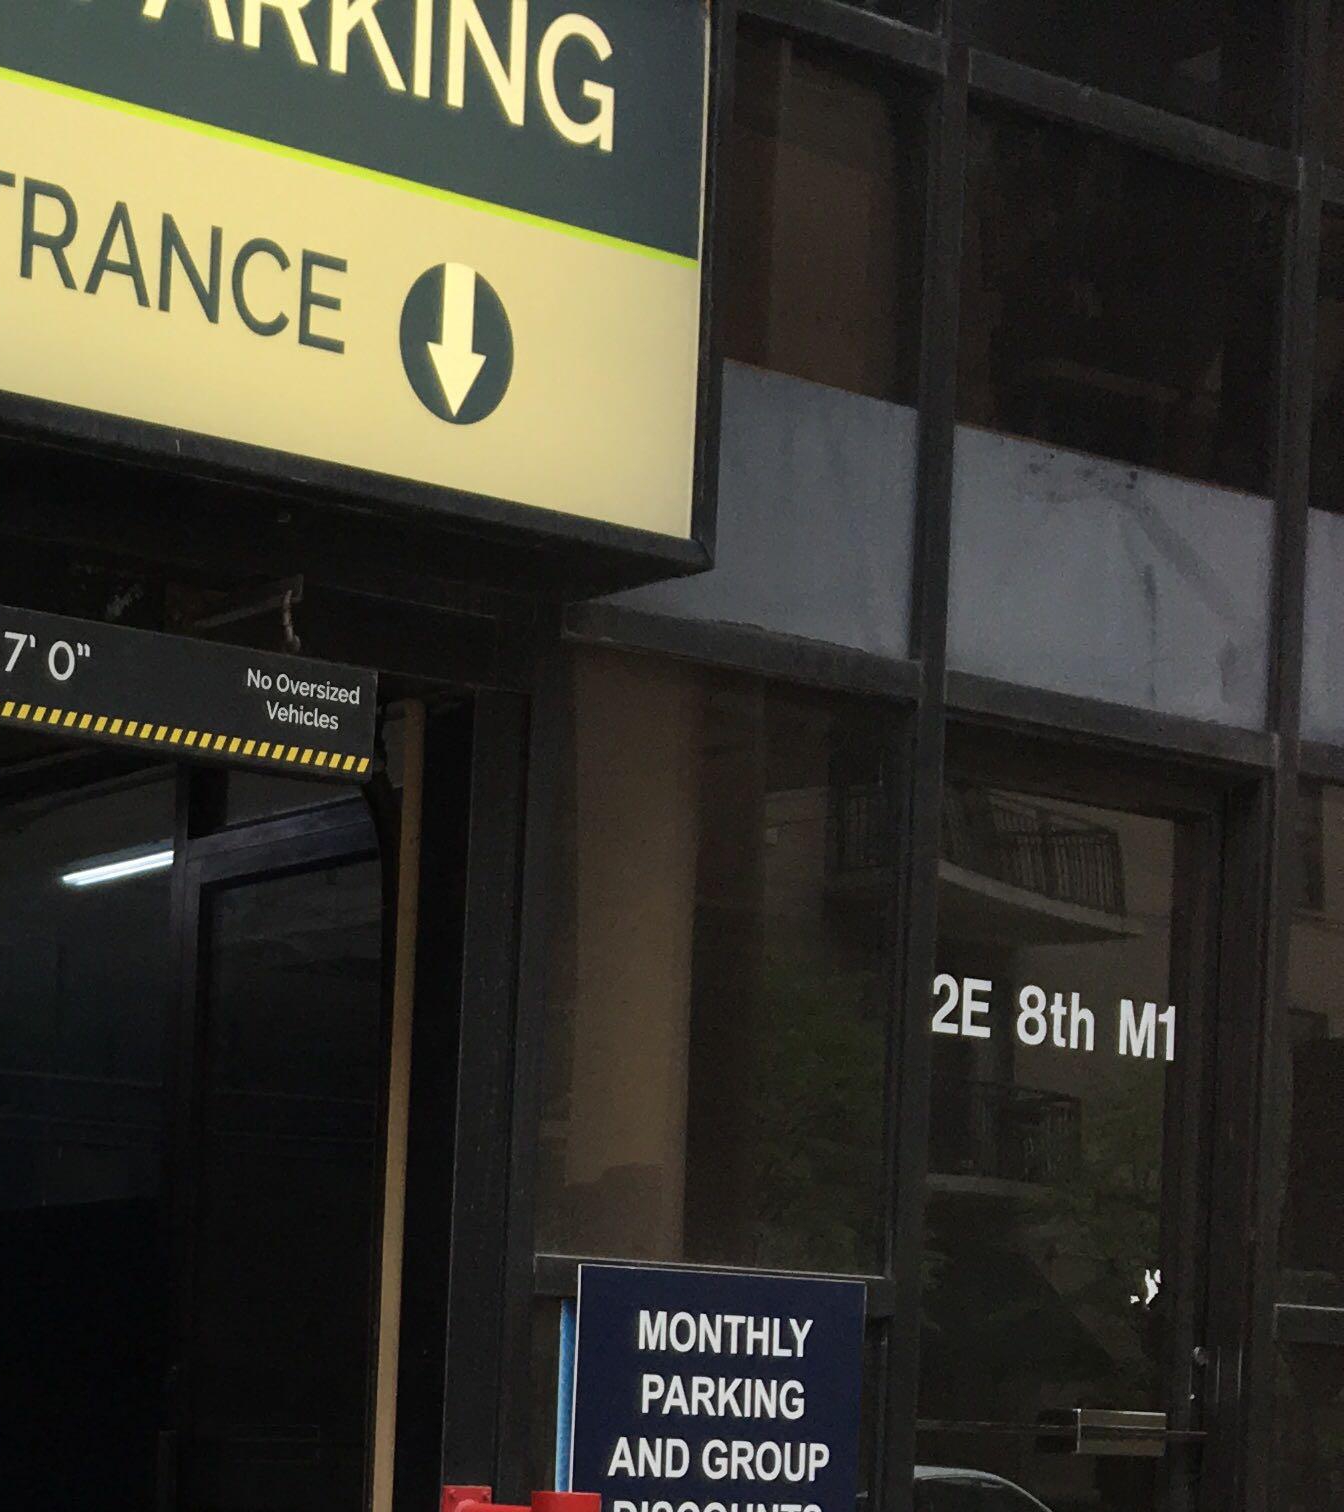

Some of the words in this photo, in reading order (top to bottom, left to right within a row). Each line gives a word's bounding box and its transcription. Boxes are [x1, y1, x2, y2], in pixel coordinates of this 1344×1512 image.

[3, 630, 37, 673] 7'
[246, 667, 272, 692] No
[276, 672, 361, 707] Oversized
[265, 699, 339, 731] Vehicles
[931, 973, 993, 1038] 2E
[1017, 984, 1095, 1051] 8th
[1118, 999, 1176, 1061] M1
[638, 1309, 814, 1358] MONTHLY
[641, 1373, 805, 1420] PARKING
[607, 1436, 690, 1479] AND
[701, 1438, 830, 1482] GROUP
